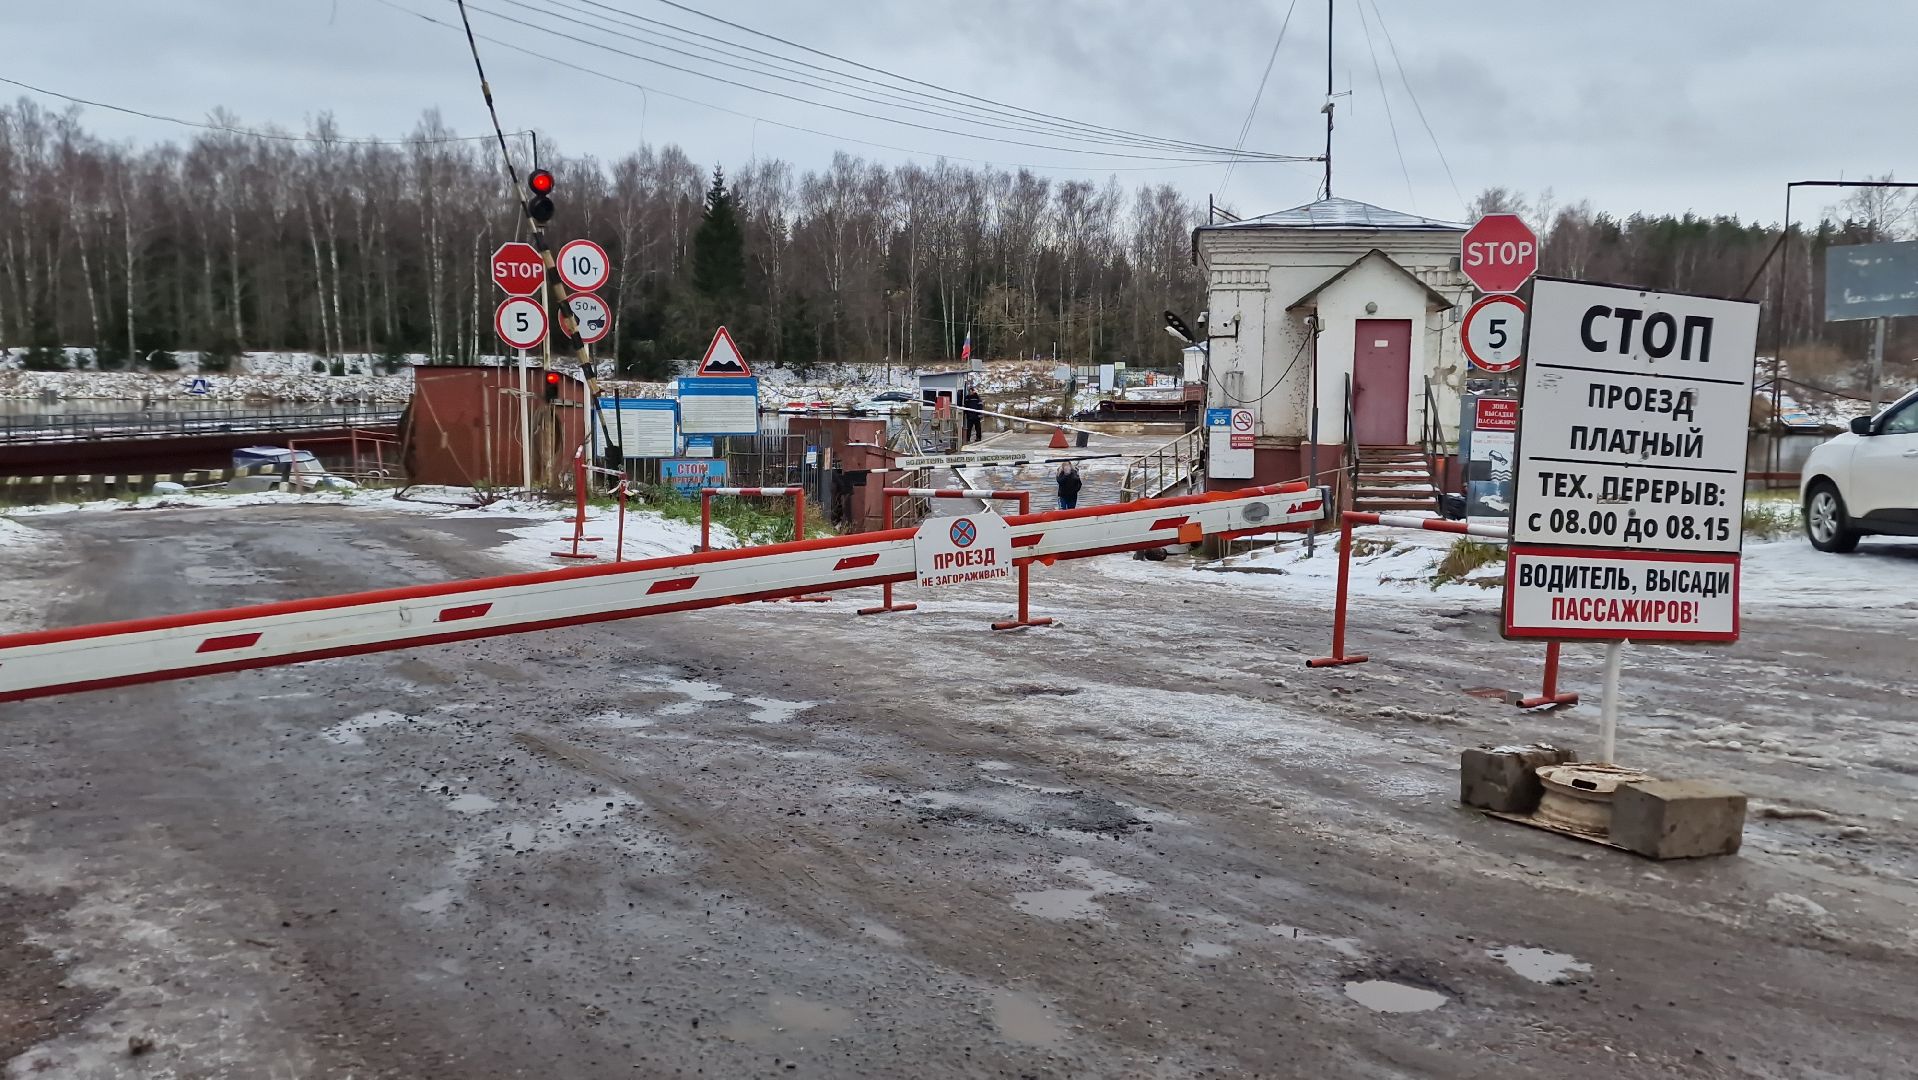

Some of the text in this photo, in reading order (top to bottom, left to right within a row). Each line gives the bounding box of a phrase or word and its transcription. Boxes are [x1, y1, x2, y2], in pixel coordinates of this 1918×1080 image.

[1466, 240, 1533, 267] STOP
[495, 261, 543, 279] STOP
[516, 312, 529, 332] 5
[1488, 319, 1507, 349] 5
[1580, 304, 1714, 362] СТОП
[1588, 383, 1694, 422] ПРОЕЗД
[1570, 425, 1704, 458] ПЛАТНЫЙ
[1538, 471, 1726, 507] ТЕХ. ПЕРЕРЫВ:
[1549, 508, 1617, 536] 08.00
[1623, 517, 1659, 543] до
[1665, 514, 1730, 542] 08.15
[933, 547, 996, 570] ПРОЕЗД
[921, 566, 1009, 587] НЕ ЗАГОРАЖИВАТЬ!
[1519, 563, 1730, 598] ВОДИТЕЛЬ, ВЫСАДИ
[1551, 597, 1699, 624] ПАССАЖИРОВ!
